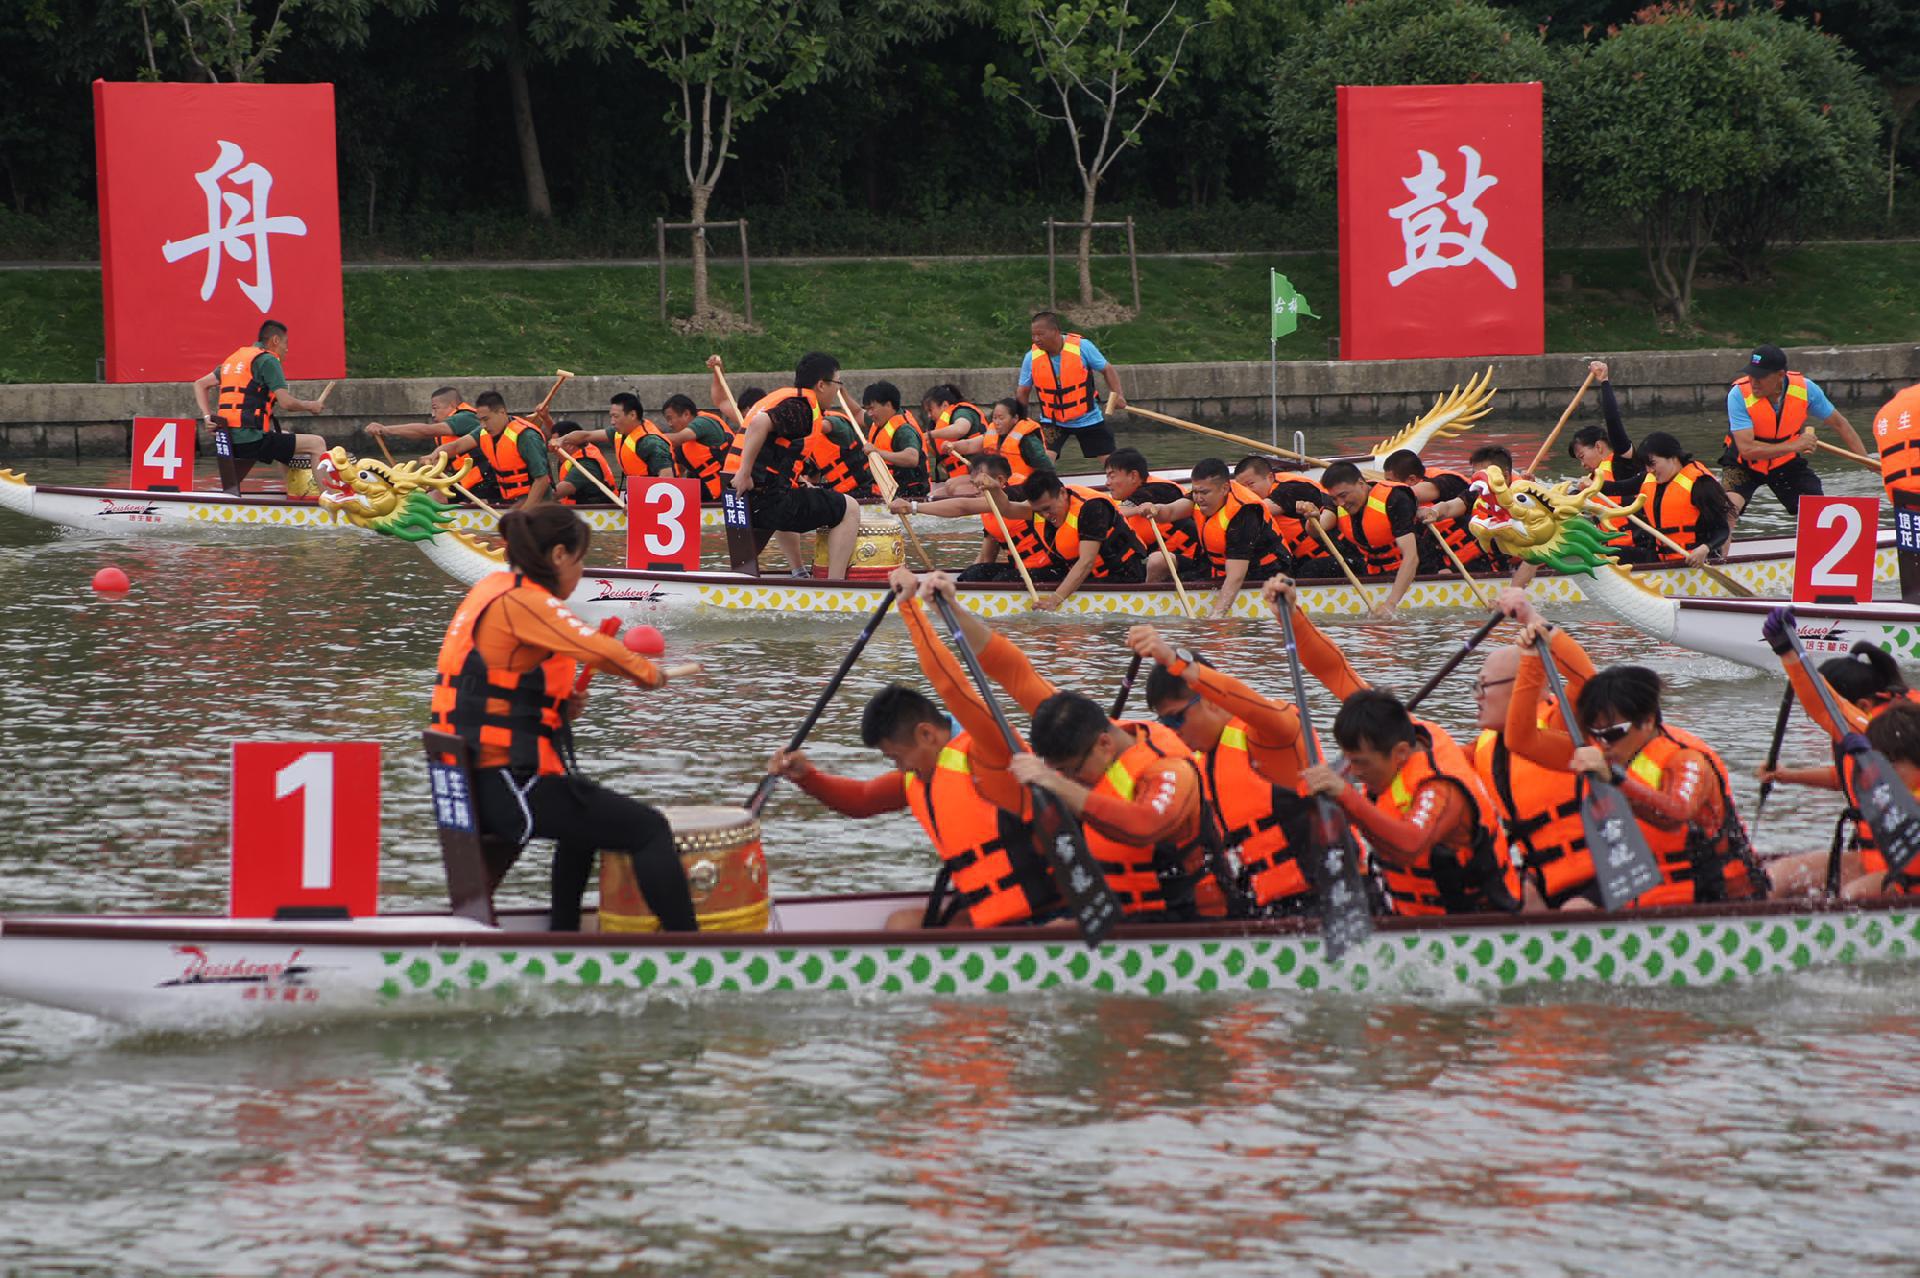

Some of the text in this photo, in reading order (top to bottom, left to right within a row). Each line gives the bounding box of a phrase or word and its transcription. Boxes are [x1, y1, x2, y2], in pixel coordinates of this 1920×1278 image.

[162, 140, 307, 313] 舟
[1388, 145, 1517, 289] 鼓
[143, 422, 182, 479] 4
[643, 482, 685, 556] 3
[1810, 503, 1862, 587] 2
[276, 751, 333, 889] 1
